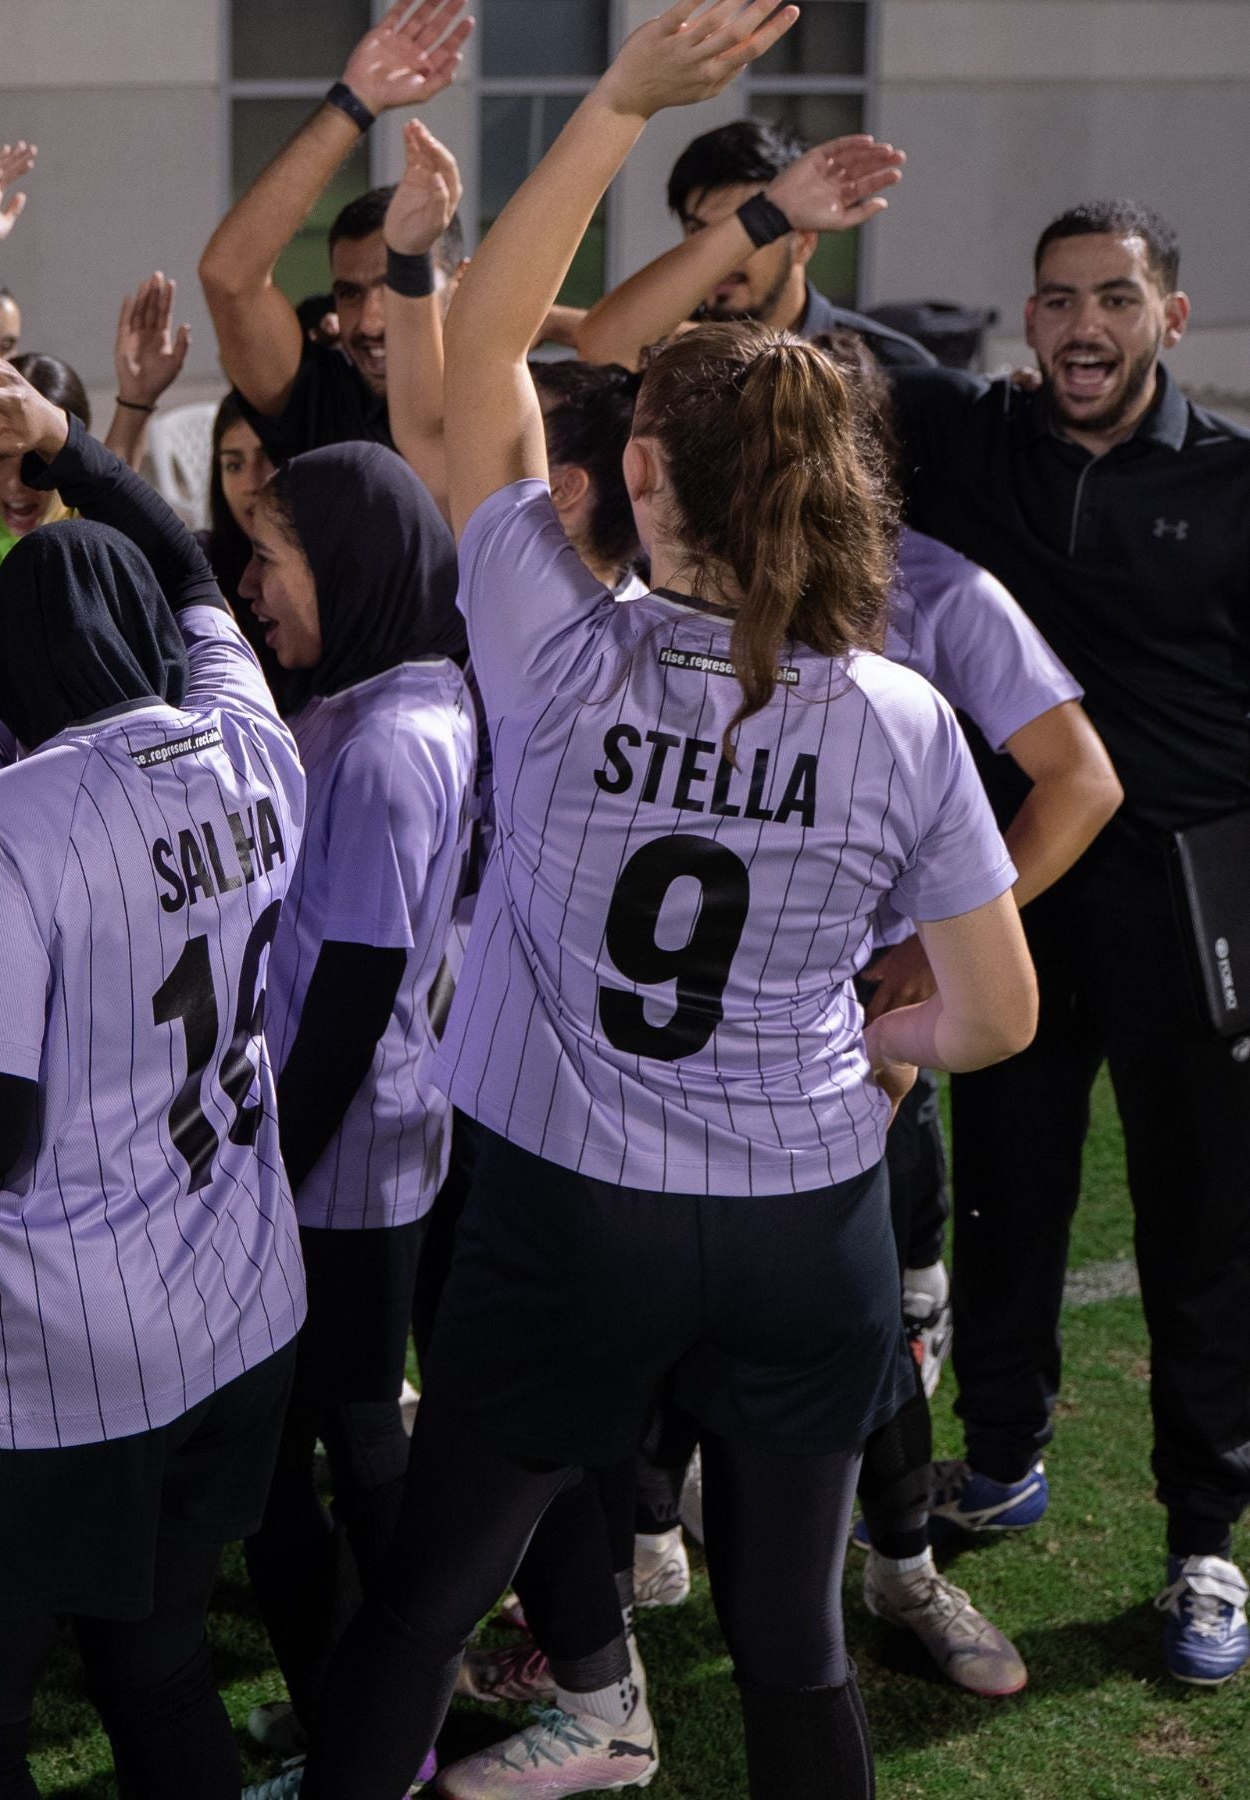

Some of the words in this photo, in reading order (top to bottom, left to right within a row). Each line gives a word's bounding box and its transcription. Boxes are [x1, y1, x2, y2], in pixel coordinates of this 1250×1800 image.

[593, 723, 815, 828] STELLA
[152, 797, 286, 913] SALHA
[598, 833, 750, 1061] 9
